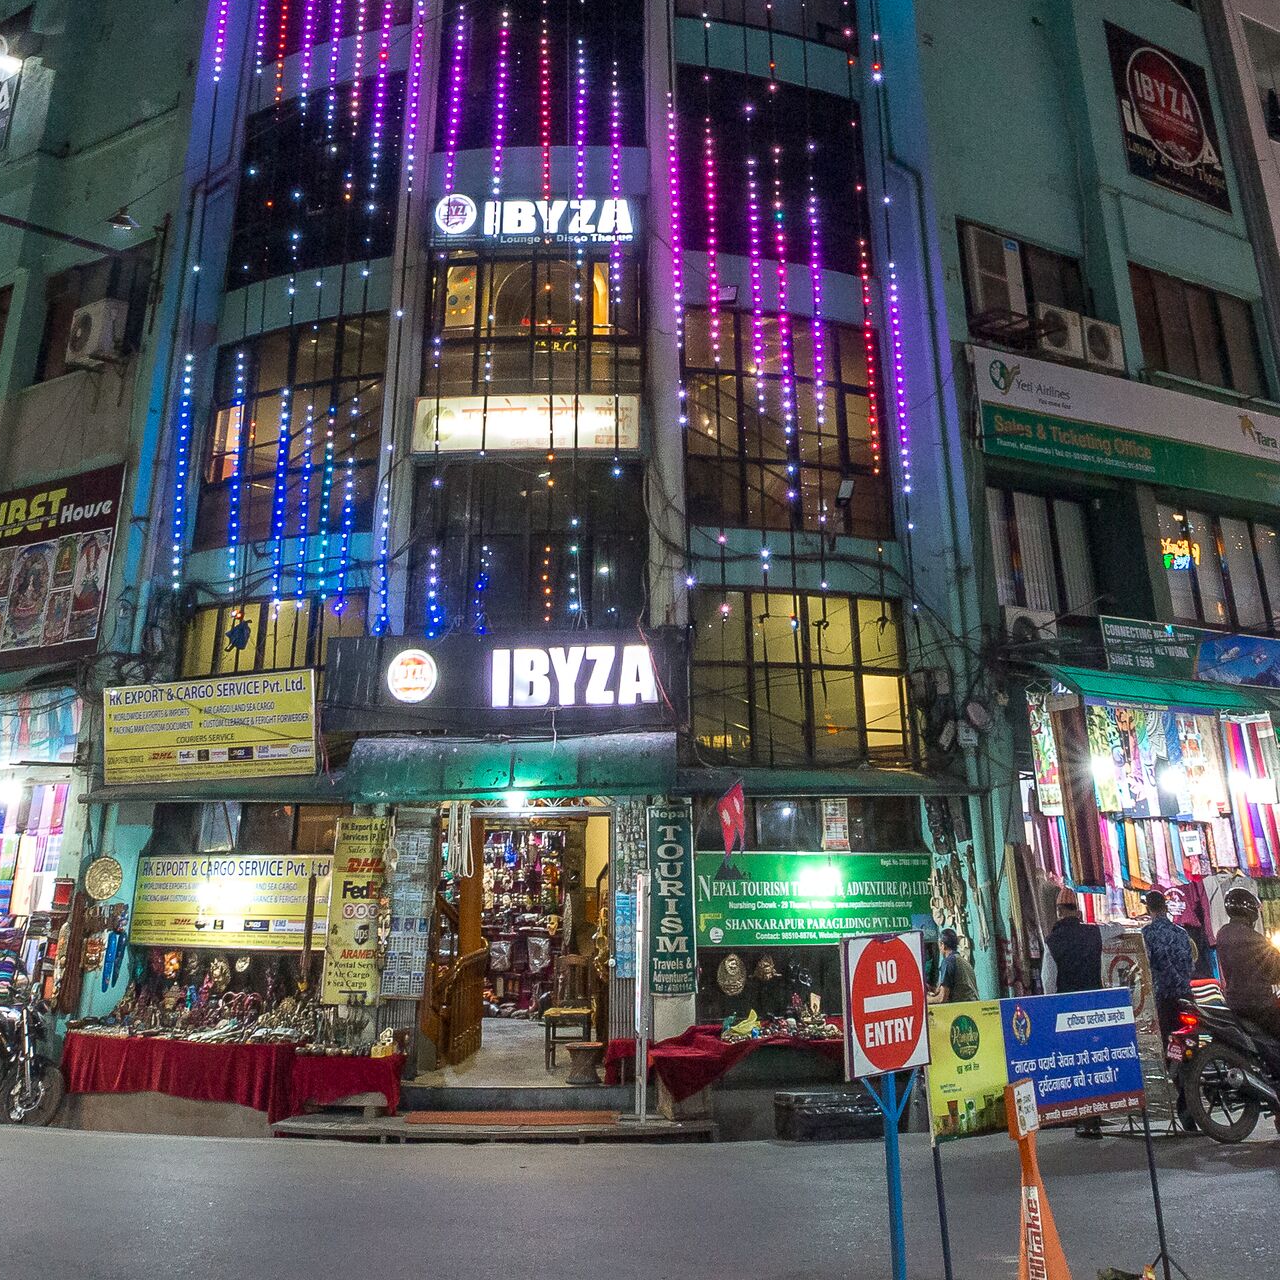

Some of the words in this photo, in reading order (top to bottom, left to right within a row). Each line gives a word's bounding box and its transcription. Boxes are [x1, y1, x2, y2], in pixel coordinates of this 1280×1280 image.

[1133, 70, 1195, 123] IBYZA
[483, 199, 634, 236] IBYZA
[500, 235, 541, 244] Lounge
[1036, 384, 1071, 400] Airlines
[994, 415, 1033, 438] Sales
[1036, 423, 1047, 441] &
[1050, 426, 1113, 456] Ticketing
[1114, 439, 1153, 461] Office
[60, 499, 113, 525] House
[1104, 623, 1152, 640] CONNECTING
[1110, 654, 1134, 668] SINCE
[491, 645, 659, 708] IBYZA
[124, 687, 166, 706] EXPORT
[167, 687, 175, 701] &
[176, 684, 214, 701] CARGO
[216, 679, 261, 698] SERVICE
[262, 679, 283, 694] Pvt.
[285, 676, 307, 692] Ltd.
[208, 732, 235, 743] SERVICE
[650, 809, 689, 820] Nepal
[155, 861, 190, 876] EXPORT
[191, 861, 198, 876] &
[200, 860, 235, 877] CARGO
[238, 860, 283, 877] SERVICE
[285, 860, 308, 877] Pvt.
[347, 857, 384, 872] DHL
[342, 880, 381, 900] FedE
[656, 824, 688, 953] TOURISM
[698, 873, 739, 903] NEPAL
[741, 880, 789, 897] TOURISM
[847, 880, 899, 897] ADVENTURE
[725, 918, 805, 931] SHANKARAPUR
[806, 917, 871, 930] PARAGLIDING
[872, 917, 892, 929] PVT.
[893, 916, 912, 928] LTD.
[653, 957, 683, 971] Travels
[875, 959, 898, 986] NO
[652, 970, 688, 984] Adventure
[864, 1015, 915, 1050] ENTRY
[1057, 1051, 1076, 1069] सेवन
[1091, 1046, 1111, 1064] सवारी
